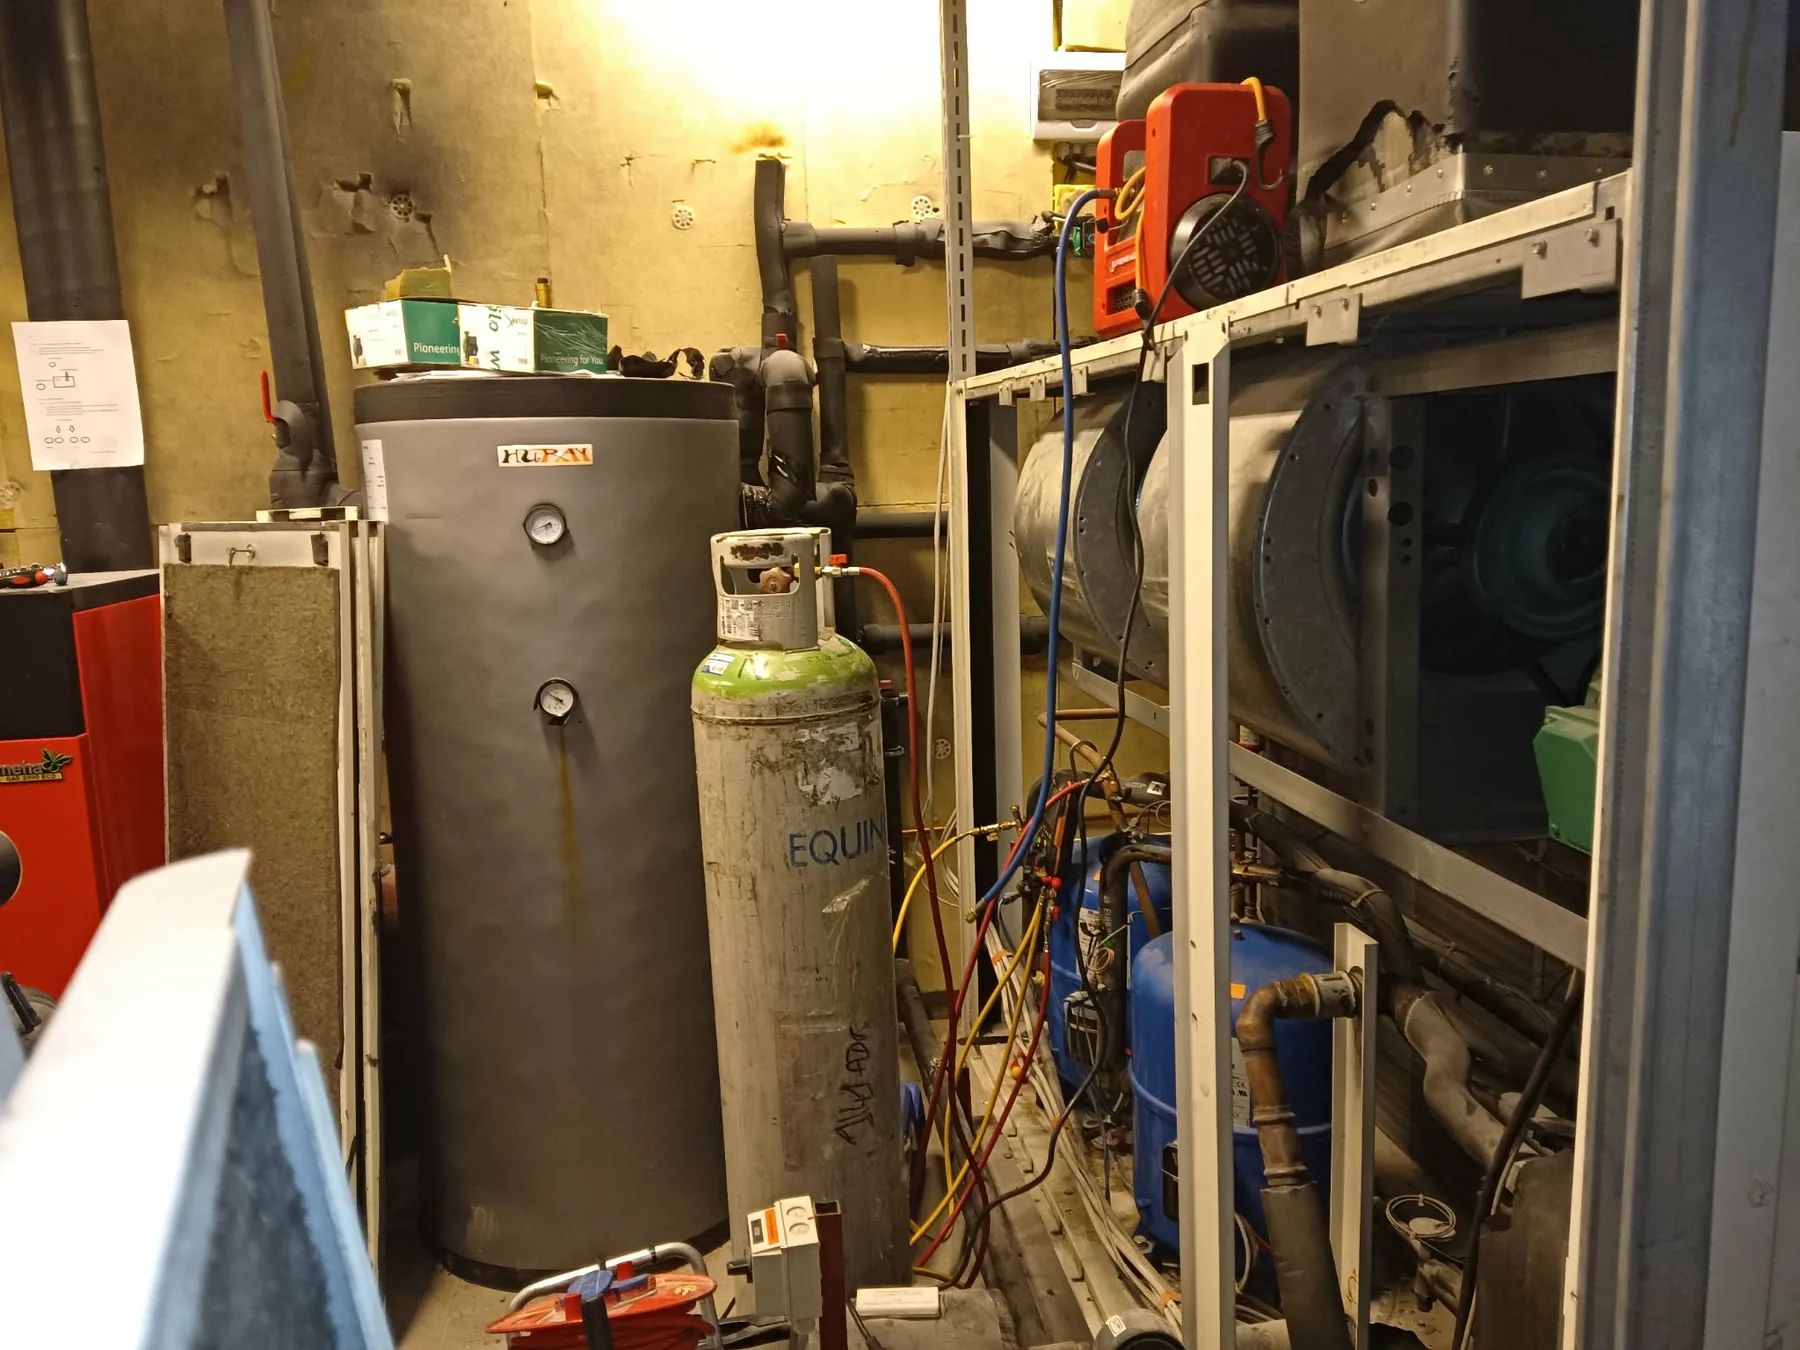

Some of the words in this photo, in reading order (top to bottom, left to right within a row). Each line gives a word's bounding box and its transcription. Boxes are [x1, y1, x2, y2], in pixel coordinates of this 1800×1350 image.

[540, 353, 578, 367] Pioneering
[579, 355, 590, 366] for
[590, 356, 604, 366] You
